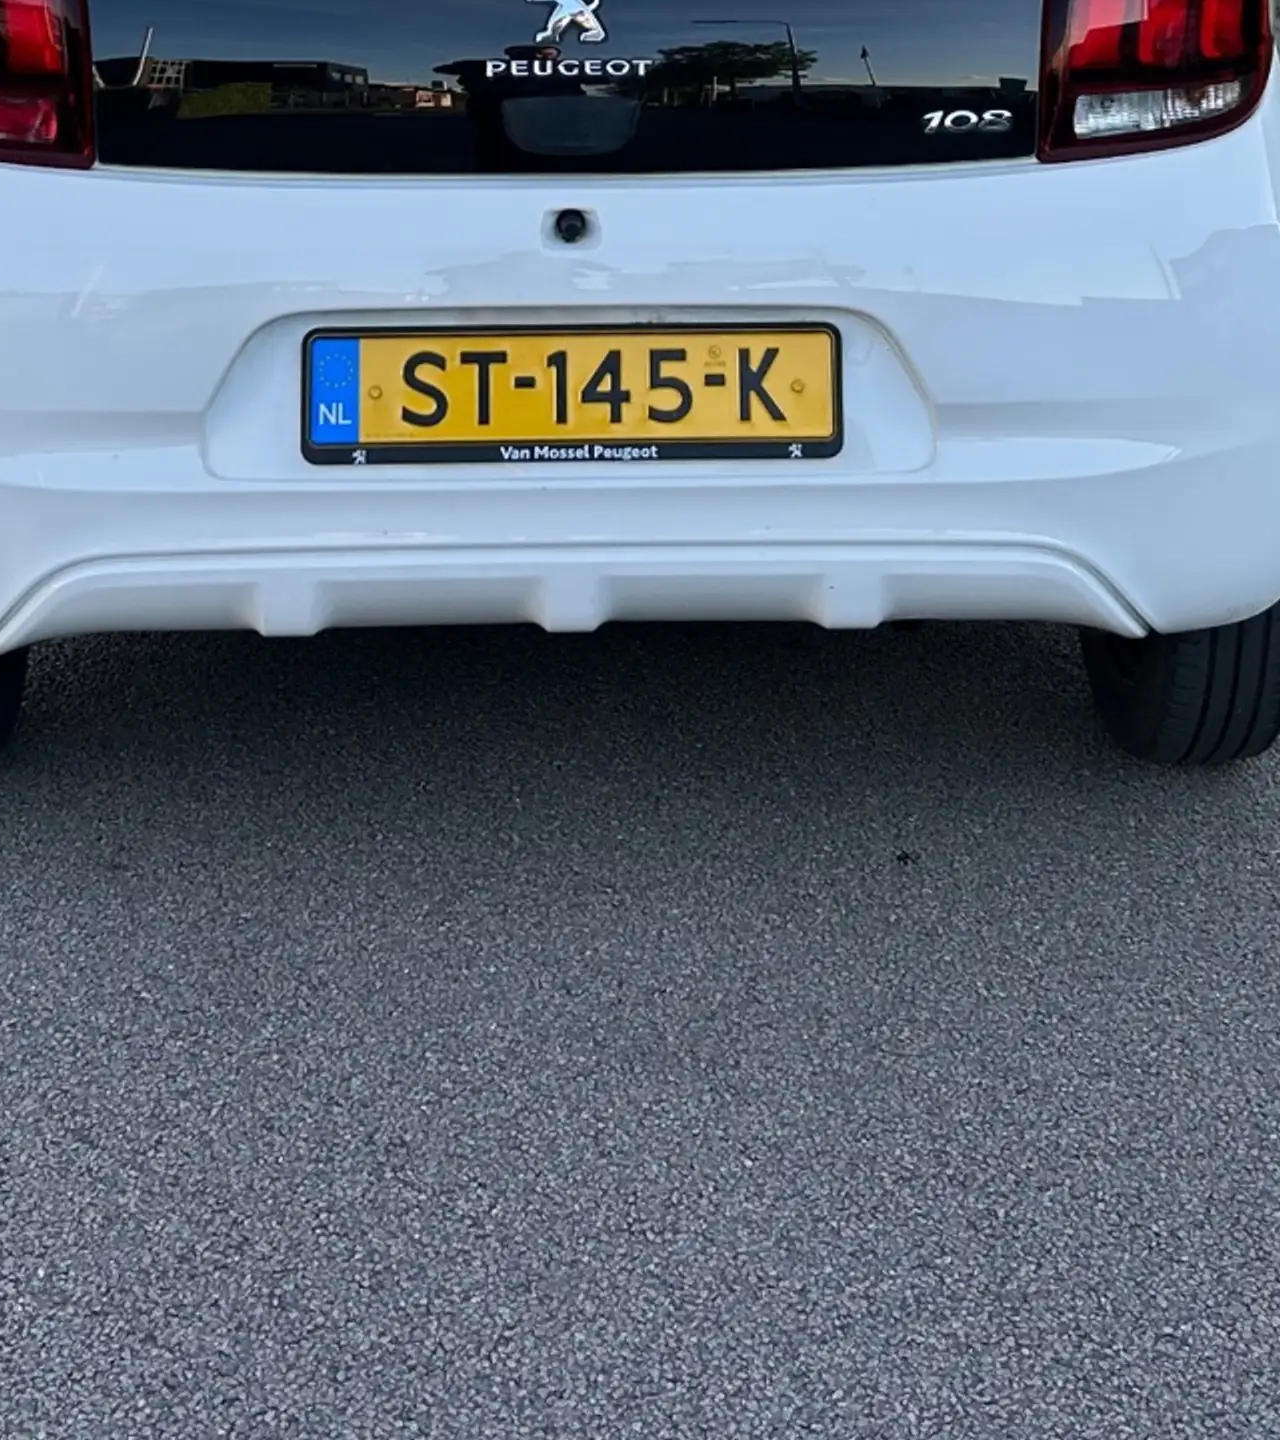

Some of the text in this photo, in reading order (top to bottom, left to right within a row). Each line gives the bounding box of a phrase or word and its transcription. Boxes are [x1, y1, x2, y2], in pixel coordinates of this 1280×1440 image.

[485, 58, 653, 78] PEUGEOT
[923, 109, 1014, 134] 108
[319, 346, 787, 428] NL ST-145-K
[499, 444, 659, 461] Van Mossel Peugeot
